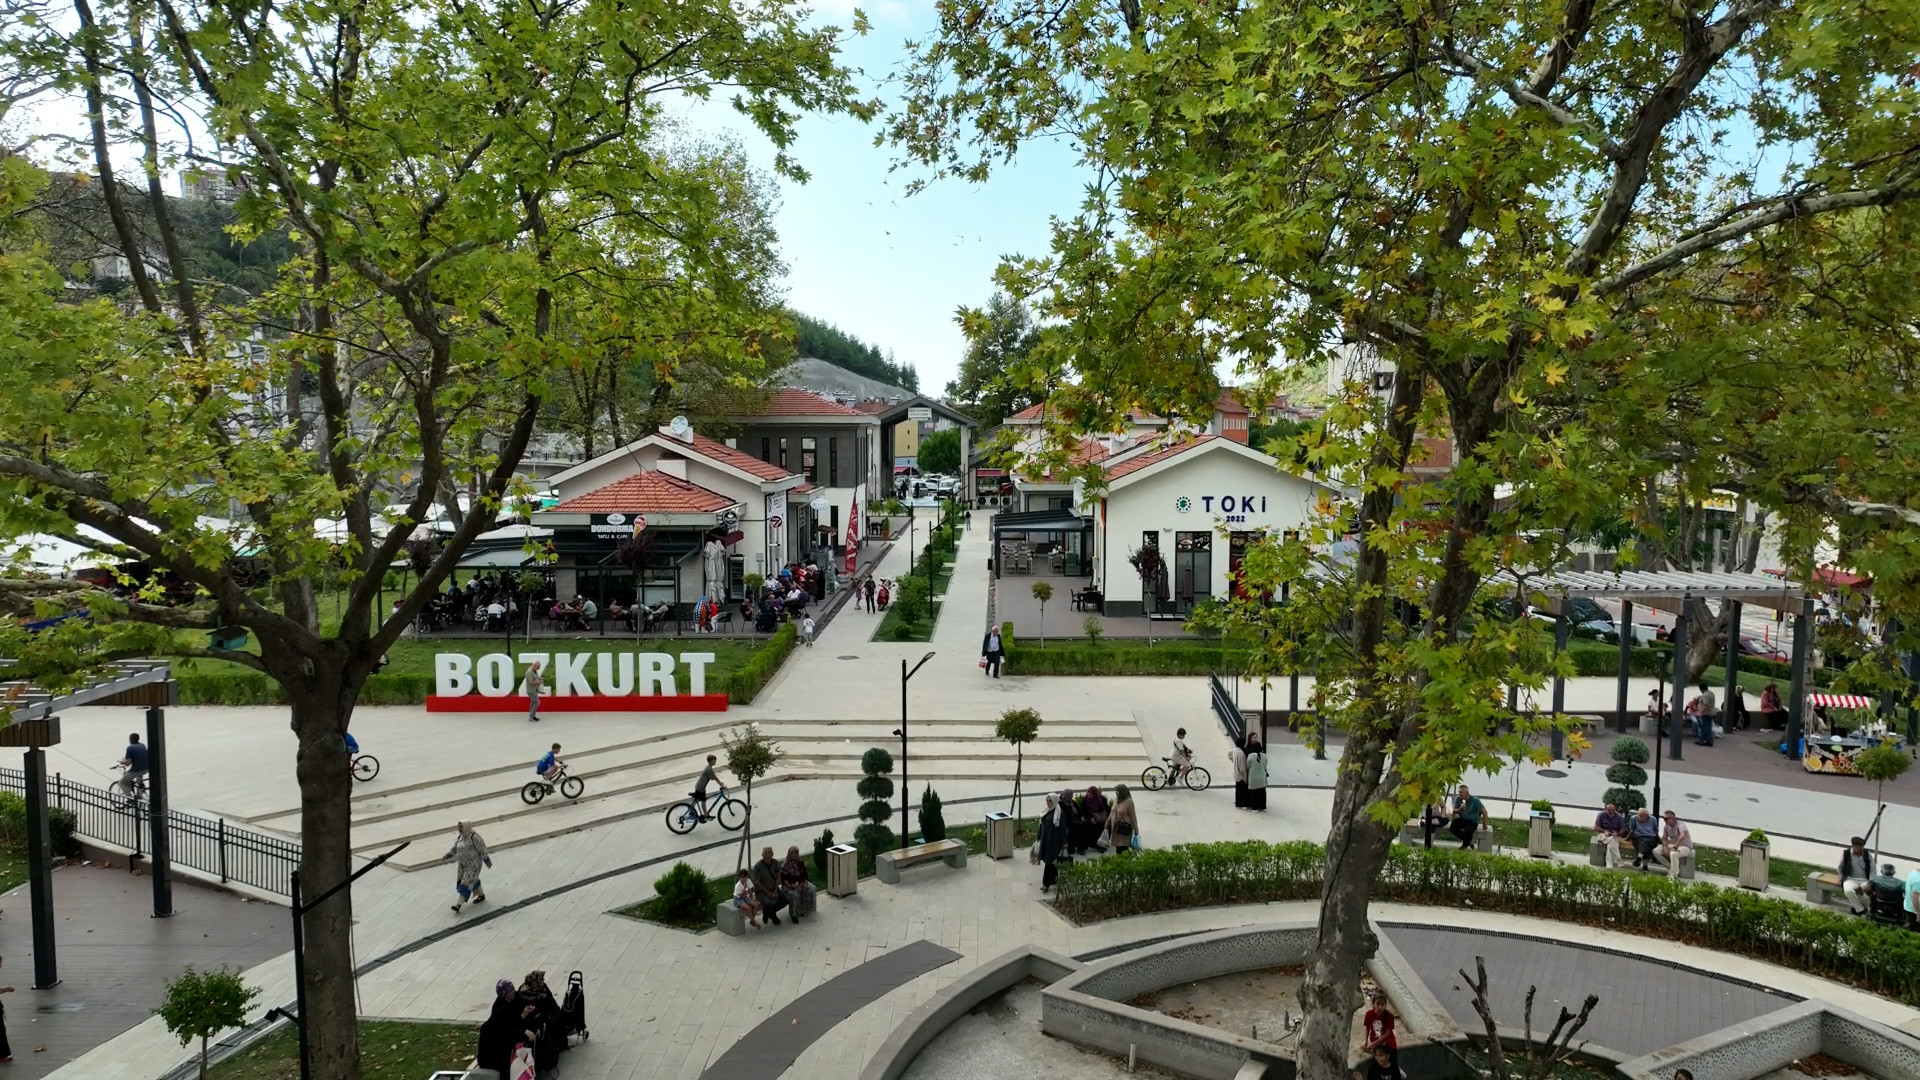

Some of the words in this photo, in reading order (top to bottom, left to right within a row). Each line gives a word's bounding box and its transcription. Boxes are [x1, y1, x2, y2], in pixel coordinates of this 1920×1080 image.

[1226, 515, 1245, 523] 2022
[591, 524, 634, 533] DONDURMA
[435, 652, 716, 698] BOZKURT
